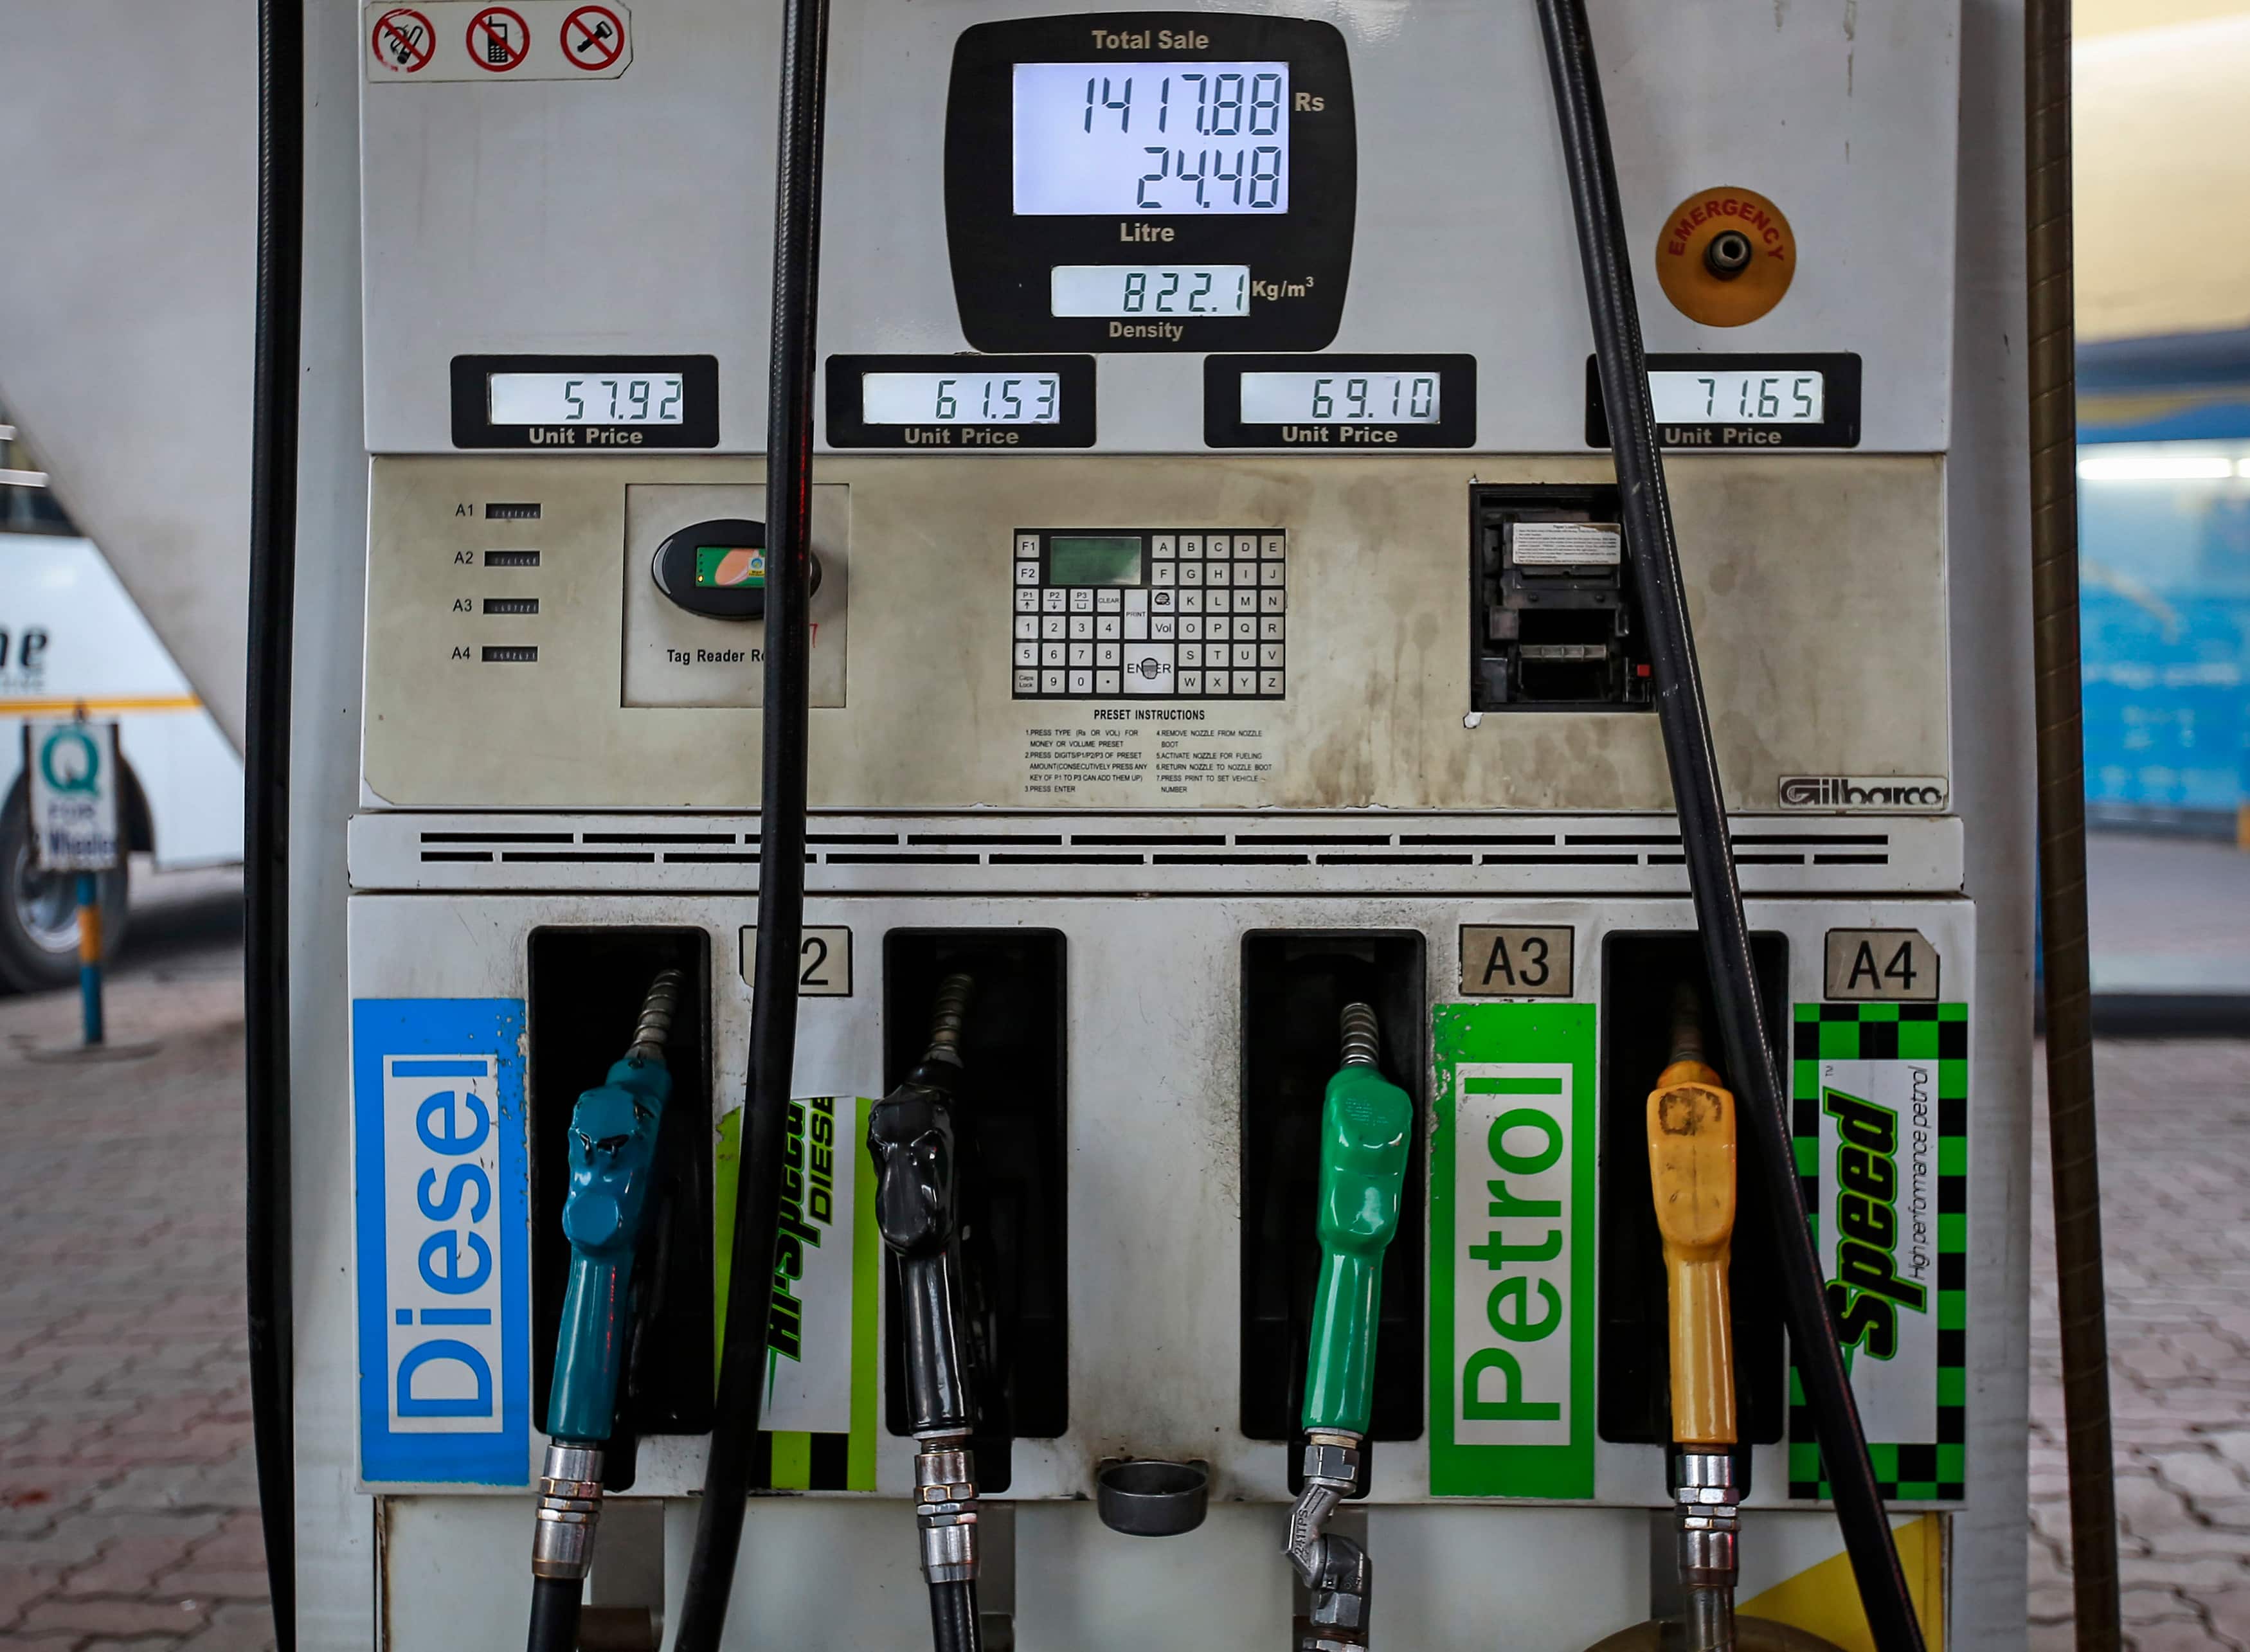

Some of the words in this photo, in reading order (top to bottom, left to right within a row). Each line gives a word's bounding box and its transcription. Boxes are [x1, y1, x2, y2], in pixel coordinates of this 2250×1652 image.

[1092, 30, 1150, 49] Total
[1158, 30, 1209, 49] Sale
[1084, 73, 1281, 136] 1417.88
[1295, 92, 1324, 112] Rs
[1137, 146, 1281, 209] 24.48
[1120, 222, 1174, 242] Litre
[1668, 199, 1785, 261] EMERGENCY
[1123, 273, 1244, 312] 822.1
[1110, 321, 1184, 342] Density
[564, 381, 682, 421] 57.92
[936, 380, 1058, 420] 61.53
[1311, 378, 1434, 418] 69.10
[1698, 378, 1812, 418] 71.65
[529, 428, 574, 444] Unit
[586, 428, 643, 444] Price
[905, 428, 948, 444] Unit
[960, 428, 1019, 444] Price
[1282, 426, 1328, 442] Unit
[1340, 426, 1398, 442] Price
[1665, 427, 1710, 444] Unit
[1722, 427, 1782, 444] Price
[455, 503, 473, 517] A1
[1022, 541, 1034, 551] F1
[1159, 542, 1168, 552] A
[1187, 542, 1195, 552] B
[1214, 542, 1223, 552] C
[1241, 542, 1250, 552] D
[1269, 542, 1277, 552] E
[454, 551, 474, 564] A2
[1021, 568, 1035, 578] F2
[1160, 569, 1168, 579] F
[1186, 569, 1196, 579] G
[1214, 570, 1223, 579] H
[1270, 569, 1276, 579] J
[453, 598, 473, 613] A3
[1187, 596, 1194, 606] K
[1214, 597, 1221, 606] L
[1241, 597, 1250, 606] M
[1268, 596, 1277, 606] N
[1051, 622, 1058, 633] 2
[1078, 622, 1085, 633] 3
[1105, 623, 1112, 632] 4
[1155, 624, 1171, 633] Vol
[1185, 623, 1196, 633] O
[1214, 623, 1222, 633] P
[1240, 623, 1250, 633] Q
[1268, 623, 1277, 633] R
[451, 646, 471, 660] A4
[667, 649, 690, 665] Tag
[697, 649, 745, 662] Reader
[1023, 649, 1030, 659] 5
[1050, 649, 1058, 660] 6
[1078, 650, 1084, 659] 7
[1105, 650, 1112, 660] 8
[1186, 650, 1194, 660] S
[1214, 650, 1221, 660] T
[1241, 651, 1250, 660] U
[1268, 651, 1276, 660] V
[1127, 663, 1171, 674] ENER
[1050, 676, 1057, 687] 9
[1077, 677, 1084, 687] 0
[1184, 678, 1196, 687] W
[1213, 678, 1221, 687] X
[1241, 678, 1248, 687] Y
[1268, 678, 1276, 688] Z
[1094, 709, 1131, 720] PRESET
[1135, 709, 1205, 720] INSTRUCTIONS
[41, 726, 100, 798] Q
[1781, 778, 1942, 805] Gilbarco
[800, 937, 829, 985] 2
[1482, 936, 1549, 987] A3
[1847, 940, 1917, 990] A4
[1908, 1066, 1930, 1128] petrol
[1907, 1129, 1930, 1244] performance
[1823, 1086, 1927, 1360] Speed
[392, 1060, 493, 1417] Diesel
[1462, 1077, 1563, 1421] Petrol
[1909, 1244, 1929, 1281] High
